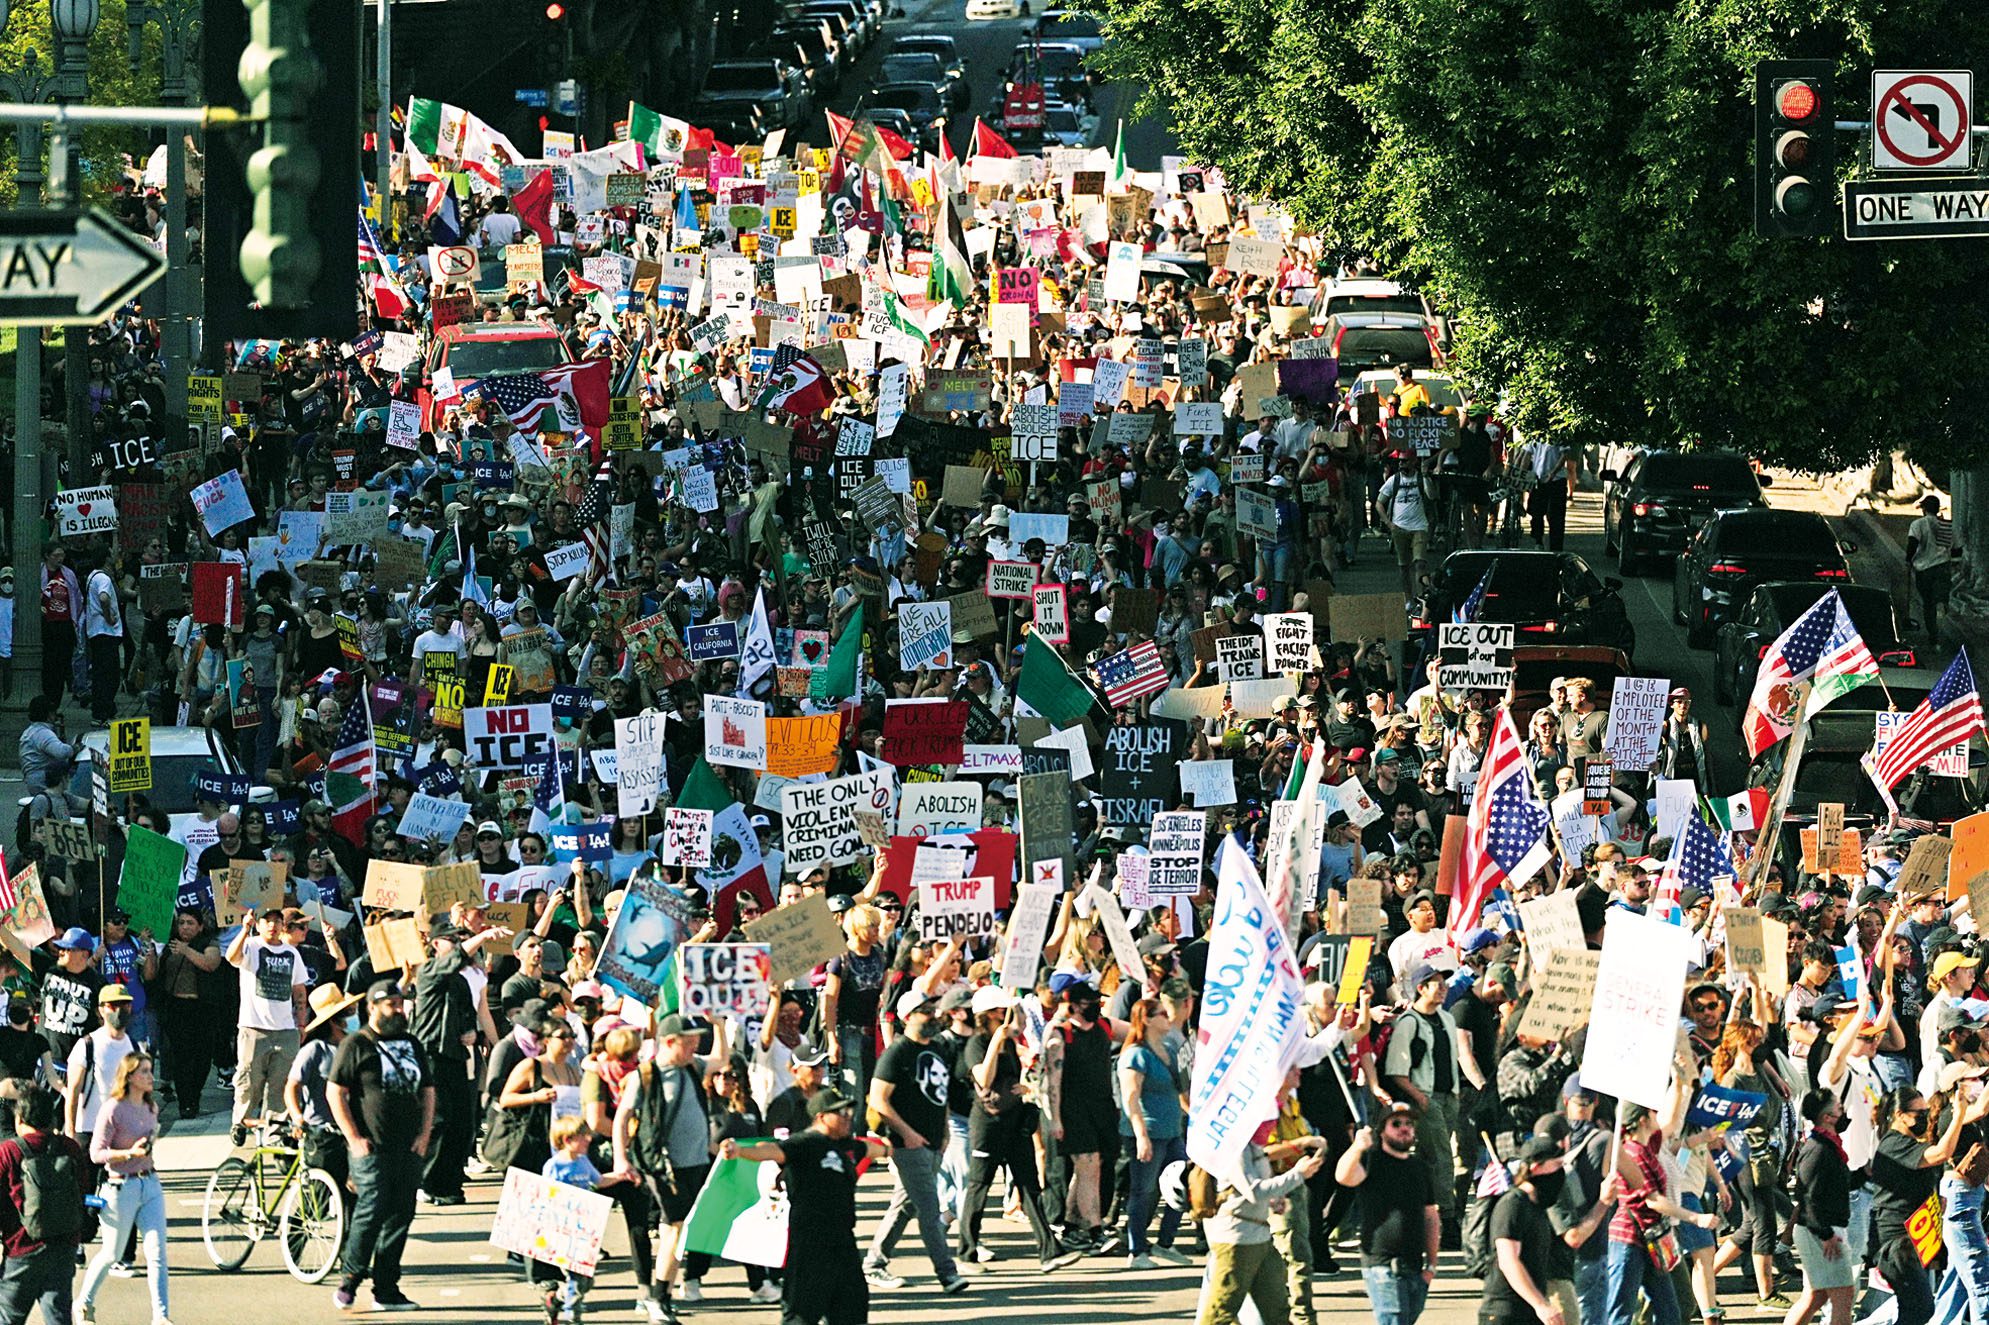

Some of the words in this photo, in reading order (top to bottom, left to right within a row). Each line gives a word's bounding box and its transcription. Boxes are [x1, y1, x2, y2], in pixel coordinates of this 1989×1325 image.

[721, 158, 740, 172] OUT
[607, 185, 642, 194] DOMESTIC
[639, 203, 651, 212] FU
[712, 205, 727, 216] ICE
[1856, 198, 1913, 223] ONE
[1934, 195, 1989, 221] WAY
[640, 215, 660, 226] ICE
[776, 208, 791, 226] ICE
[507, 245, 542, 254] MELT
[1001, 272, 1032, 289] NO
[1000, 290, 1034, 300] CROWN
[758, 300, 799, 317] IMMIGRANTS
[692, 313, 730, 340] ABOLISH
[708, 327, 730, 345] ICE
[353, 341, 369, 352] ICE
[1180, 342, 1201, 352] HERE
[1304, 348, 1330, 359] STOLEN
[956, 370, 987, 378] PEOPLE
[192, 379, 214, 388] FULL
[944, 382, 976, 391] MELT
[189, 388, 219, 398] RIGHTS
[464, 389, 480, 399] ICE
[189, 405, 202, 413] FOR
[204, 405, 218, 413] ALL
[626, 412, 639, 420] FOR
[1012, 405, 1057, 414] ABOLISH
[1187, 405, 1211, 417] Fuck
[1012, 414, 1057, 423] ABOLISH
[1189, 419, 1213, 431] ICE
[1388, 418, 1402, 427] NO
[1406, 417, 1448, 427] JUSTICE
[612, 425, 631, 434] KEITH
[1012, 424, 1057, 434] ABOLISH
[1388, 428, 1405, 438] NO
[1408, 427, 1456, 438] FUCKING
[1013, 435, 1056, 460] ICE
[1408, 439, 1441, 449] PEACE
[110, 436, 155, 469] ICE
[333, 455, 354, 464] TRUMP
[794, 447, 822, 462] MELT
[336, 464, 353, 472] MUST
[842, 461, 863, 474] ICE
[1246, 457, 1263, 465] ICE
[475, 468, 492, 479] ICE
[1241, 470, 1263, 479] NAZIS
[685, 479, 709, 492] NAZIS
[841, 475, 866, 487] OUT
[58, 493, 74, 505] NO
[76, 488, 113, 502] HUMAN
[688, 488, 709, 499] AFRAID
[1097, 483, 1110, 496] NO
[195, 490, 225, 512] FUCK
[1090, 491, 1120, 508] HUMAN
[66, 519, 78, 531] IS
[81, 516, 118, 531] ILLEGAL
[809, 521, 834, 538] WILL
[548, 553, 568, 571] STOP
[809, 547, 840, 566] SILENT
[145, 566, 161, 577] THE
[993, 563, 1033, 579] NATIONAL
[993, 579, 1027, 592] STRIKE
[1036, 591, 1060, 605] SHUT
[900, 605, 922, 628] WE
[1044, 607, 1053, 619] IT
[705, 627, 719, 637] ICE
[900, 626, 923, 644] ARE
[924, 608, 948, 632] ALL
[1038, 620, 1064, 634] DOWN
[1276, 628, 1308, 639] FIGHT
[1444, 627, 1471, 644] ICE
[1477, 626, 1513, 643] OUT
[693, 638, 733, 651] CALIFORNIA
[901, 624, 951, 669] IMMIGRANT
[1219, 640, 1233, 650] THE
[1234, 638, 1253, 649] IDF
[1276, 643, 1311, 657] FACIST
[425, 653, 455, 669] CHINGA
[1221, 649, 1261, 663] TRAINS
[1468, 649, 1480, 661] of
[1480, 651, 1495, 662] our
[1228, 663, 1255, 677] ICE
[1275, 658, 1309, 671] POWER
[494, 667, 509, 695] ICE
[1439, 670, 1511, 686] COMMUNITY!
[1624, 679, 1656, 691] ICE
[435, 682, 465, 710] NO
[552, 692, 571, 705] ICE
[1615, 692, 1665, 708] EMPLOYEE
[486, 709, 529, 734] NO
[887, 707, 941, 726] FUCK
[944, 707, 967, 725] ICE
[1616, 709, 1631, 720] OF
[1633, 709, 1654, 720] THE
[626, 717, 656, 744] STOP
[1616, 722, 1657, 736] MONTH
[118, 722, 141, 753] ICE
[388, 732, 412, 741] DEFENSE
[1104, 727, 1171, 754] ABOLISH
[1613, 738, 1627, 748] AT
[1627, 737, 1647, 748] THE
[475, 734, 548, 767] ICE
[709, 746, 722, 755] JUST
[723, 748, 735, 757] LIKE
[883, 736, 917, 754] FUCK
[921, 735, 962, 754] TRUMP
[115, 757, 126, 769] OUT
[126, 757, 133, 768] OF
[133, 756, 146, 767] OUR
[524, 763, 547, 776] ICE
[1115, 752, 1153, 776] ICE
[1611, 760, 1650, 770] STORE
[112, 768, 149, 782] COMMUNITIES
[1189, 765, 1222, 779] CHINGA
[200, 780, 221, 794] ICE
[1201, 779, 1215, 790] LA
[1586, 777, 1611, 786] LARGUE
[789, 791, 826, 811] THE
[831, 778, 880, 803] ONLY
[1197, 790, 1226, 804] MIGRA
[1586, 788, 1609, 798] TRUMP
[411, 800, 445, 815] WRONG
[915, 796, 976, 814] ABOLISH
[786, 802, 858, 830] VIOLENT
[1824, 811, 1841, 825] FUCK
[50, 822, 84, 840] ICE
[929, 822, 967, 835] ICE
[1166, 818, 1202, 832] ANGELES
[1571, 823, 1582, 832] LA
[552, 835, 578, 850] ICE
[1563, 834, 1596, 854] MIGRA
[1825, 828, 1840, 846] ICE
[52, 838, 89, 860] OUT
[1152, 839, 1200, 851] MINNEAPOLIS
[788, 844, 825, 864] NEED
[1150, 857, 1199, 868] STOP
[1149, 869, 1162, 885] ICE
[1164, 868, 1198, 885] TERROR
[931, 881, 981, 901] TRUMP
[430, 890, 450, 910] OF
[923, 912, 993, 938] PENDEJO
[687, 947, 760, 983] ICE
[44, 997, 89, 1024] UP
[1602, 991, 1668, 1026] STRIKE
[1696, 1094, 1729, 1117] ICE
